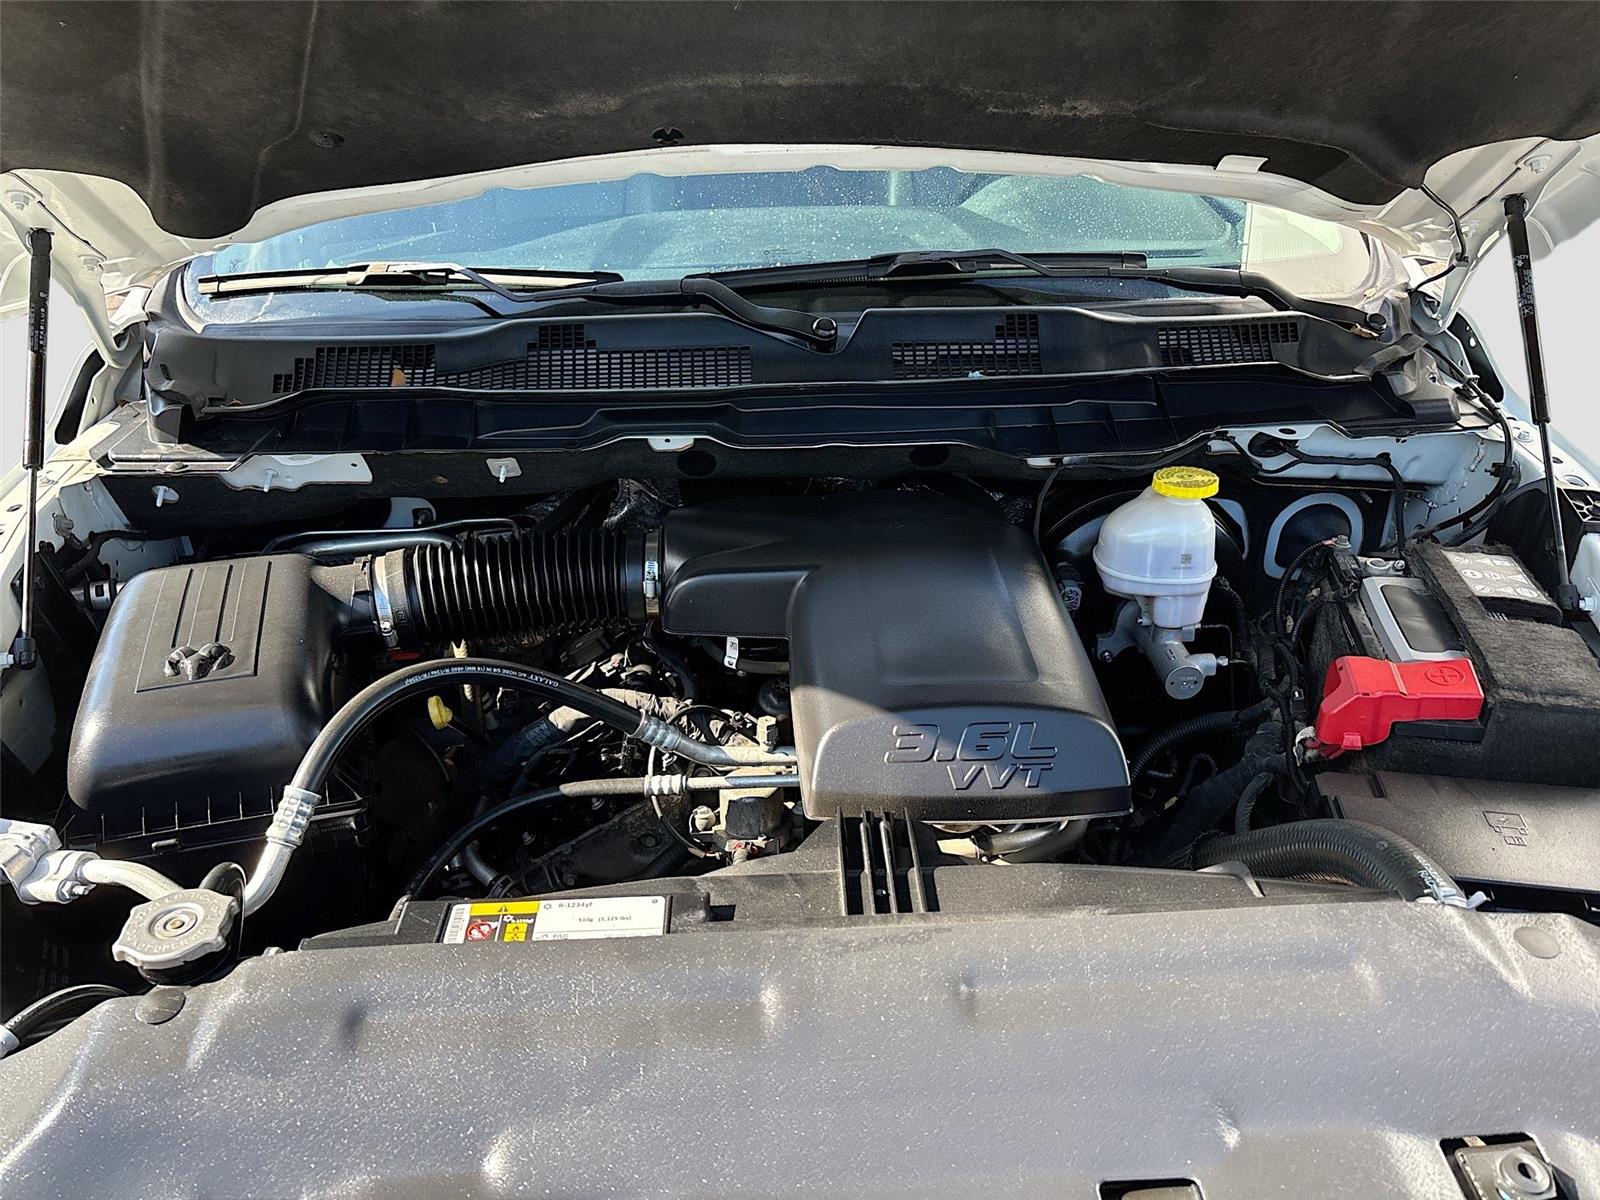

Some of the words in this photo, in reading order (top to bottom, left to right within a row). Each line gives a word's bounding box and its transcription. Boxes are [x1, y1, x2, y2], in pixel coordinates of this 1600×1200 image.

[528, 673, 559, 688] GALAXY
[884, 721, 1058, 763] 3.6L
[946, 762, 1054, 790] VVT
[558, 901, 593, 909] R-1234yf
